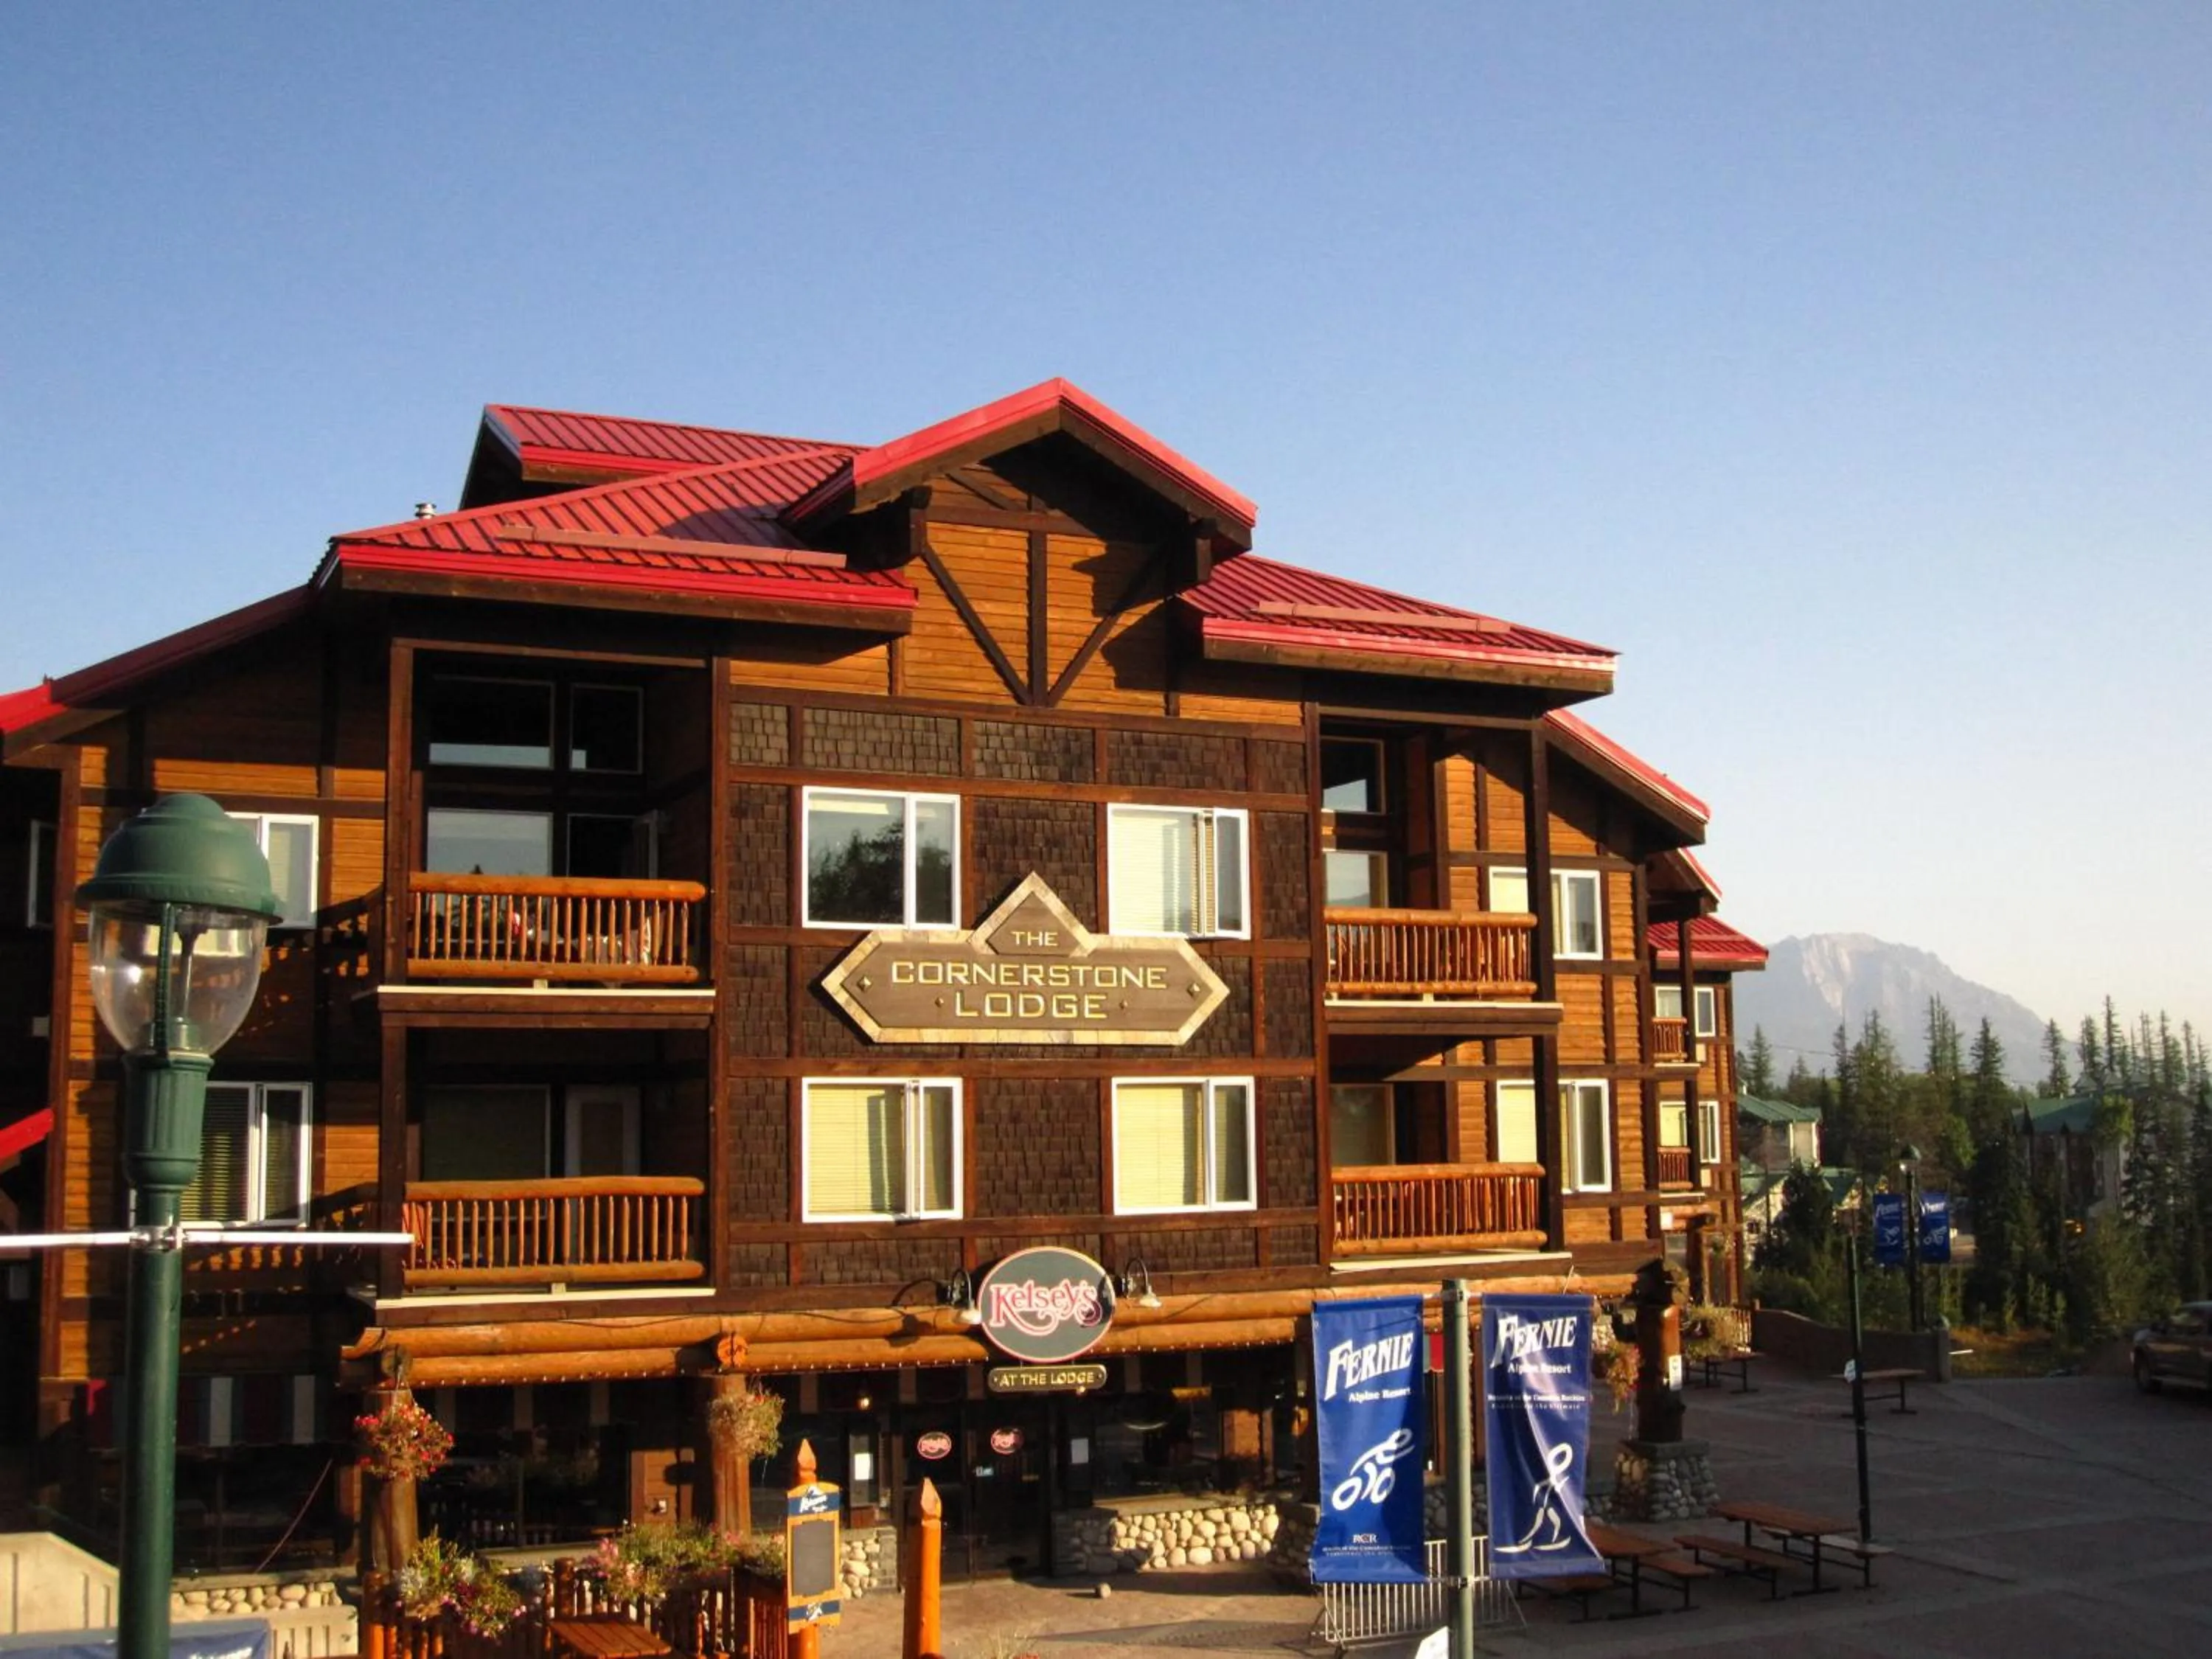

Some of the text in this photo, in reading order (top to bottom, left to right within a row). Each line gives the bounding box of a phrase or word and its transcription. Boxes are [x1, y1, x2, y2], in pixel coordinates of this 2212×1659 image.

[1010, 931, 1058, 947] THE
[891, 961, 1167, 990] CORNERSTONE
[954, 991, 1107, 1019] LODGE
[990, 1278, 1103, 1336] Kelsey's
[1489, 1315, 1577, 1369] FERNIE
[999, 1371, 1095, 1387] AT THE LODGE
[1324, 1332, 1414, 1402] FERNIE
[1507, 1362, 1538, 1374] Alp
